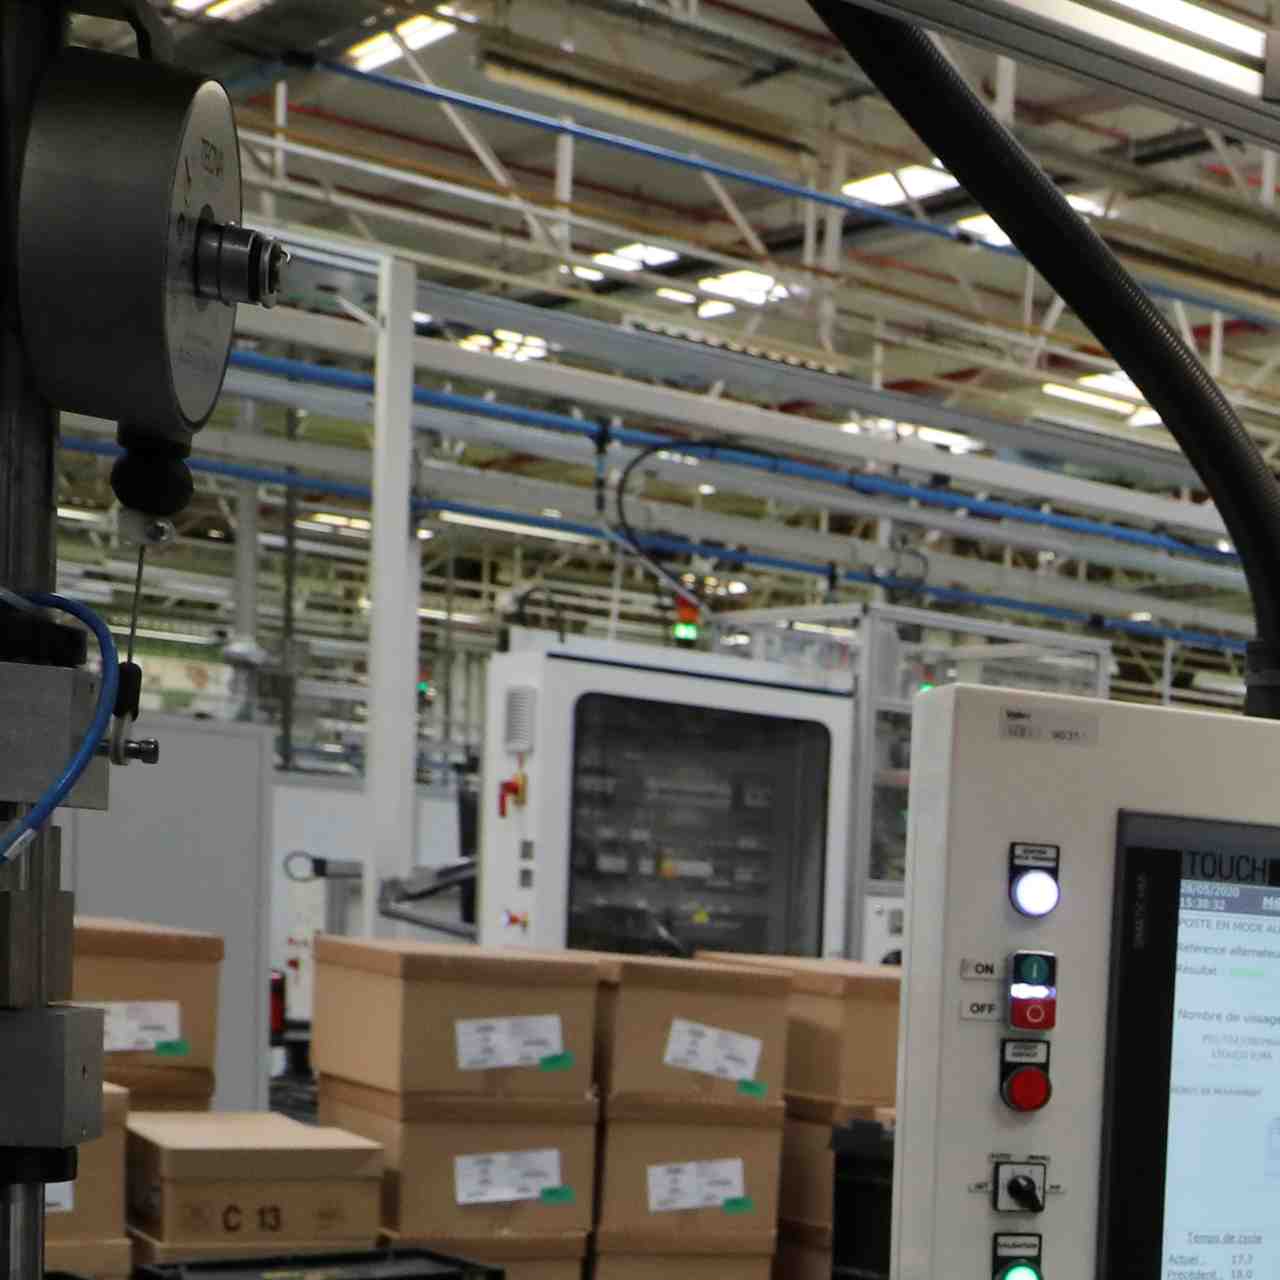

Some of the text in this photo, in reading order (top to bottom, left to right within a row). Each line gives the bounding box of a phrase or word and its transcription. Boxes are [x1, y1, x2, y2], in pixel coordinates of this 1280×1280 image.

[1188, 851, 1266, 881] TOUCH
[1232, 921, 1263, 934] MODE
[976, 962, 994, 975] ON
[970, 1003, 995, 1014] OFF
[222, 1204, 281, 1232] C 13
